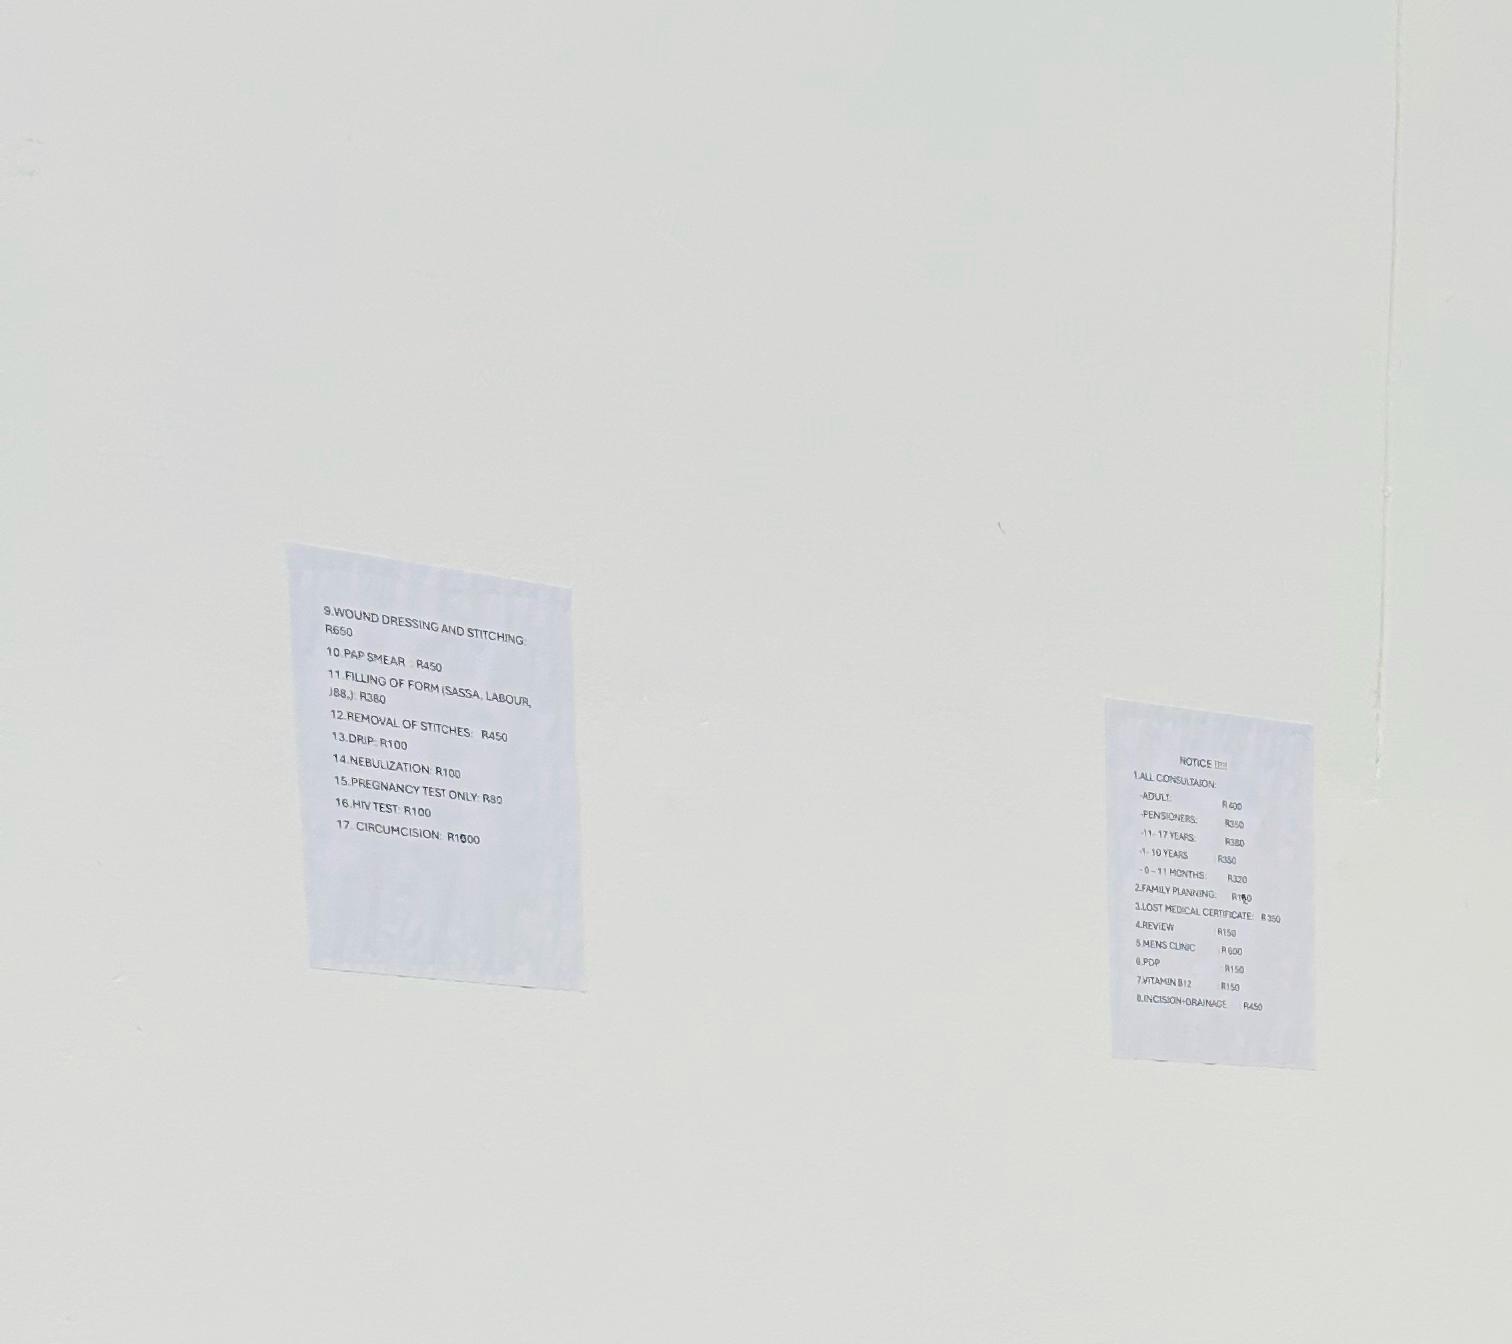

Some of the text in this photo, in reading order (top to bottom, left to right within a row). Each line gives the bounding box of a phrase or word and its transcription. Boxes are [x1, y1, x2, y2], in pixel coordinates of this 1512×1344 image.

[382, 615, 439, 631] DRESSING
[441, 625, 464, 636] AND
[389, 679, 404, 688] OF
[409, 680, 439, 694] FORM
[402, 719, 417, 729] OF
[481, 730, 507, 742] R450
[380, 738, 407, 750] R100
[1180, 756, 1212, 768] NOTICE
[435, 766, 461, 779] R100
[423, 786, 445, 797] TEST
[404, 806, 431, 817] R100
[1165, 904, 1200, 916] MEDICAL
[1170, 942, 1196, 951] CLINIC
